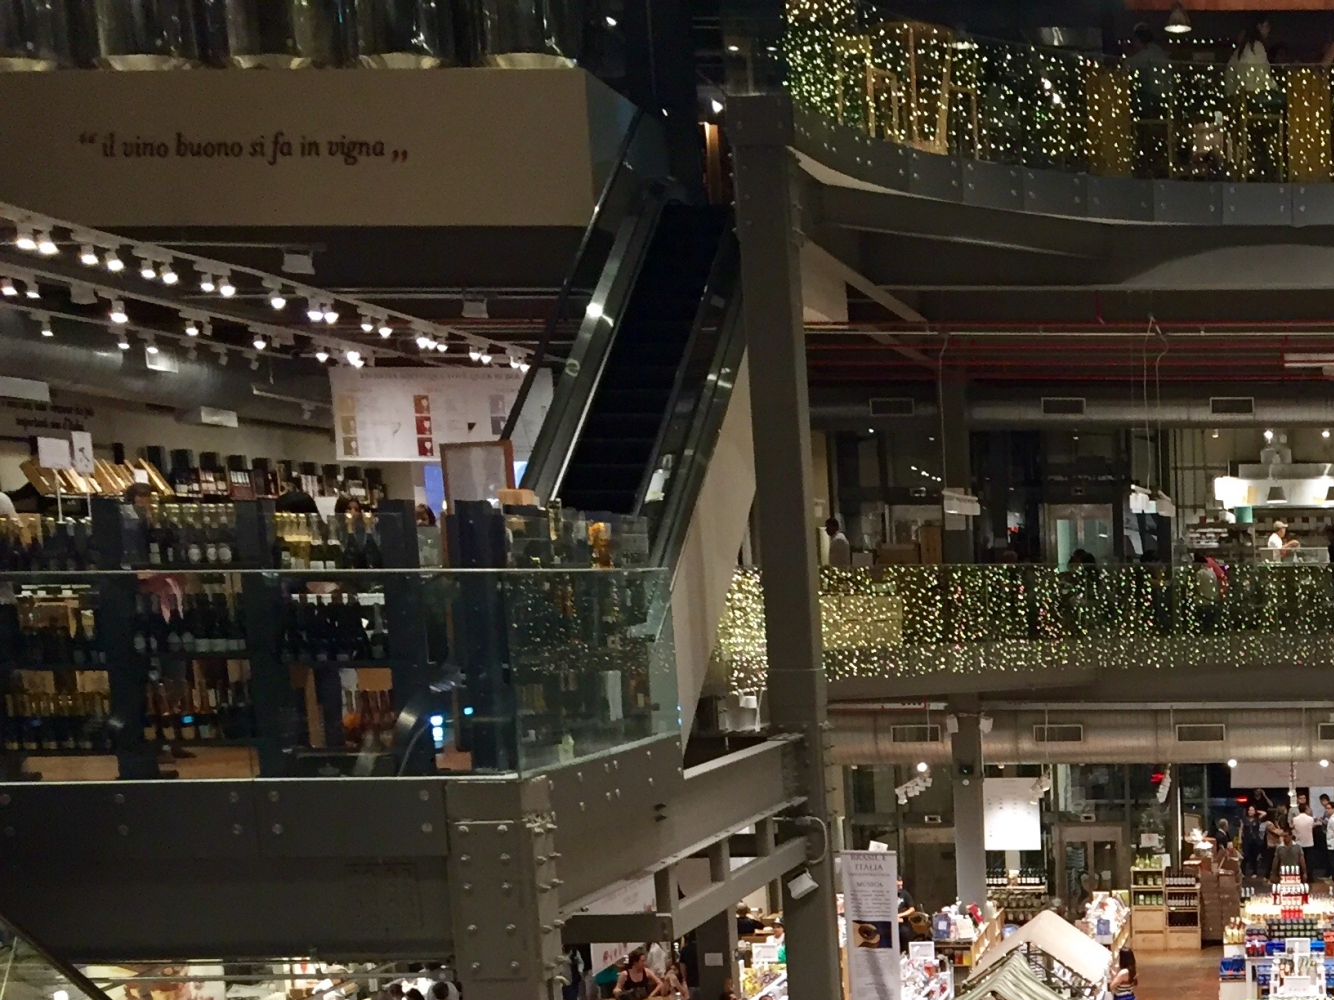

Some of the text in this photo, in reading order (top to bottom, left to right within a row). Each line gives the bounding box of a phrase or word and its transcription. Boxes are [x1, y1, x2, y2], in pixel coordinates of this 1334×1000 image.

[122, 135, 170, 158] vino
[176, 132, 243, 157] buono
[249, 135, 265, 157] si
[267, 131, 293, 166] fa
[301, 135, 320, 157] in
